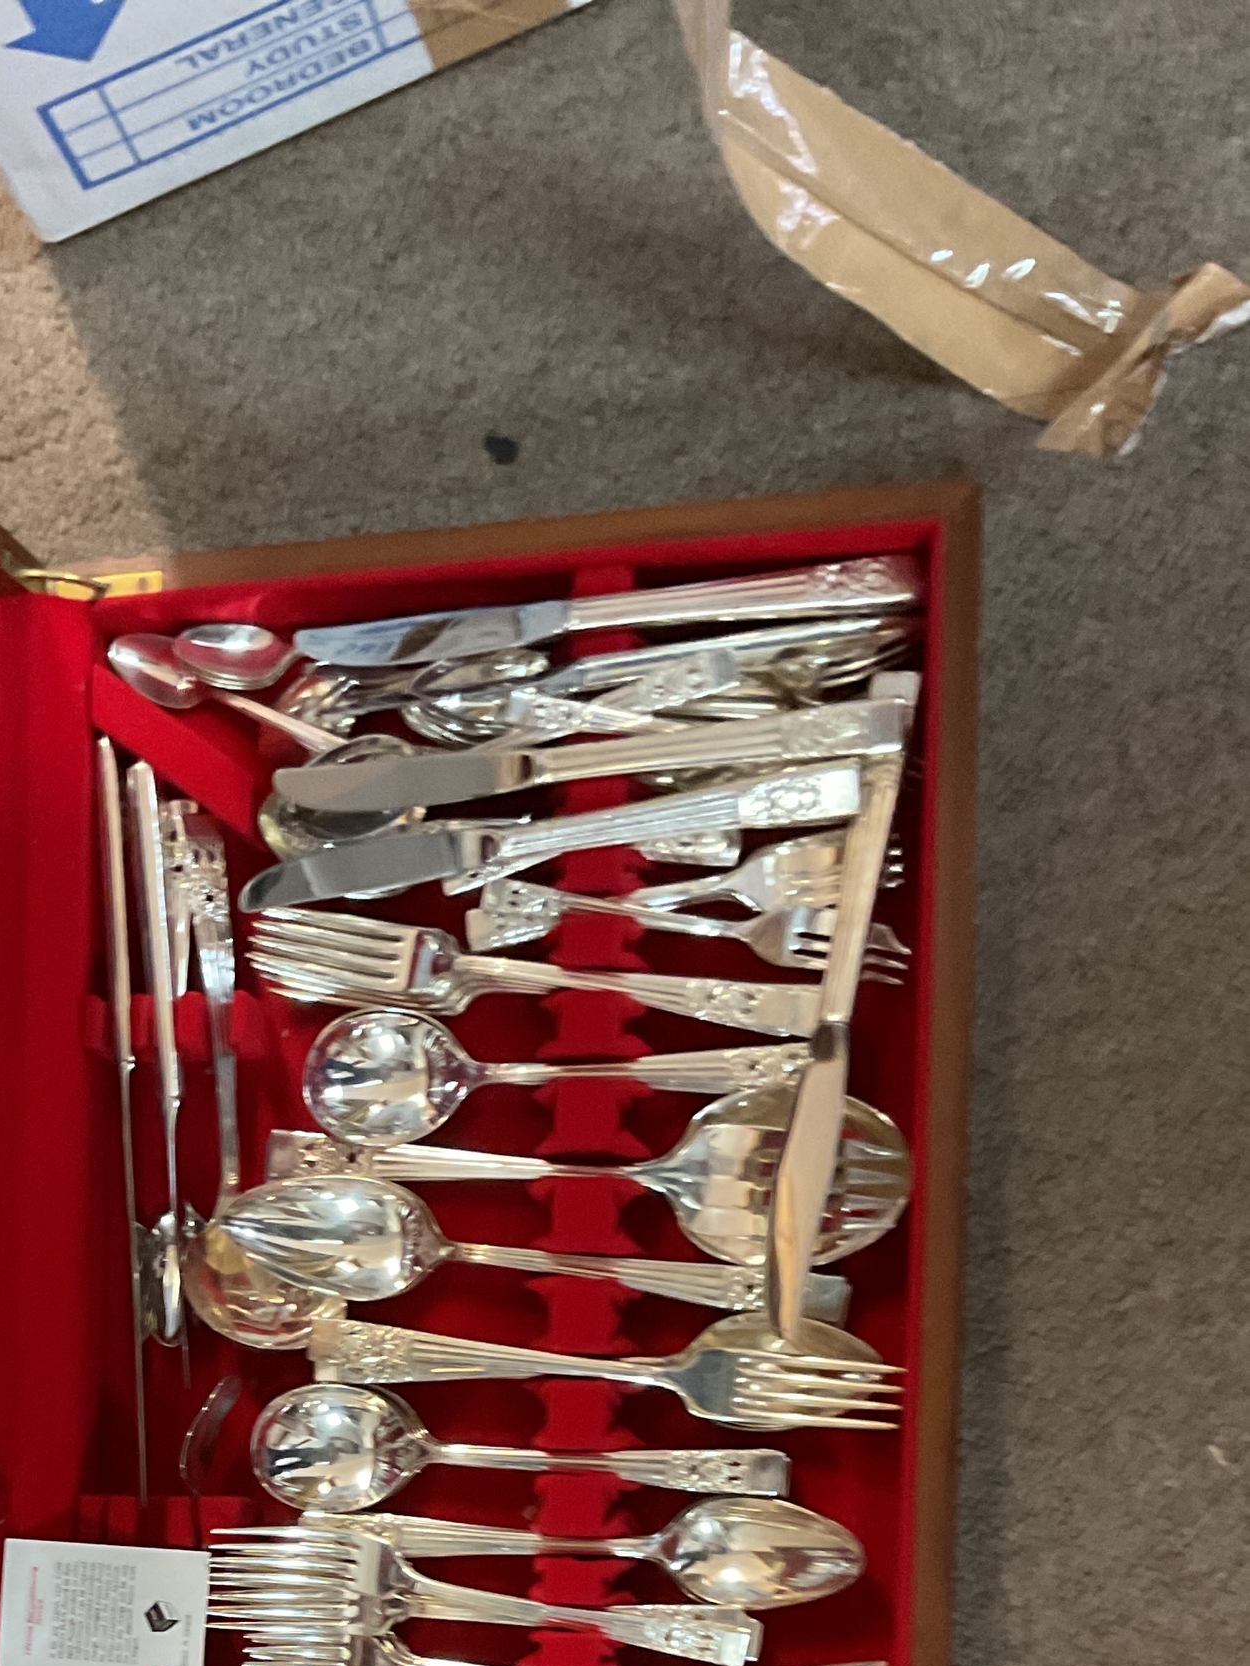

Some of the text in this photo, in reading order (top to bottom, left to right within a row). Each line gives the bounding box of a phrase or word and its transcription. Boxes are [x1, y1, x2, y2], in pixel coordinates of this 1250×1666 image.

[174, 0, 352, 70] ENERAL
[246, 12, 365, 77] STUDY
[186, 38, 375, 131] BEDROOM
